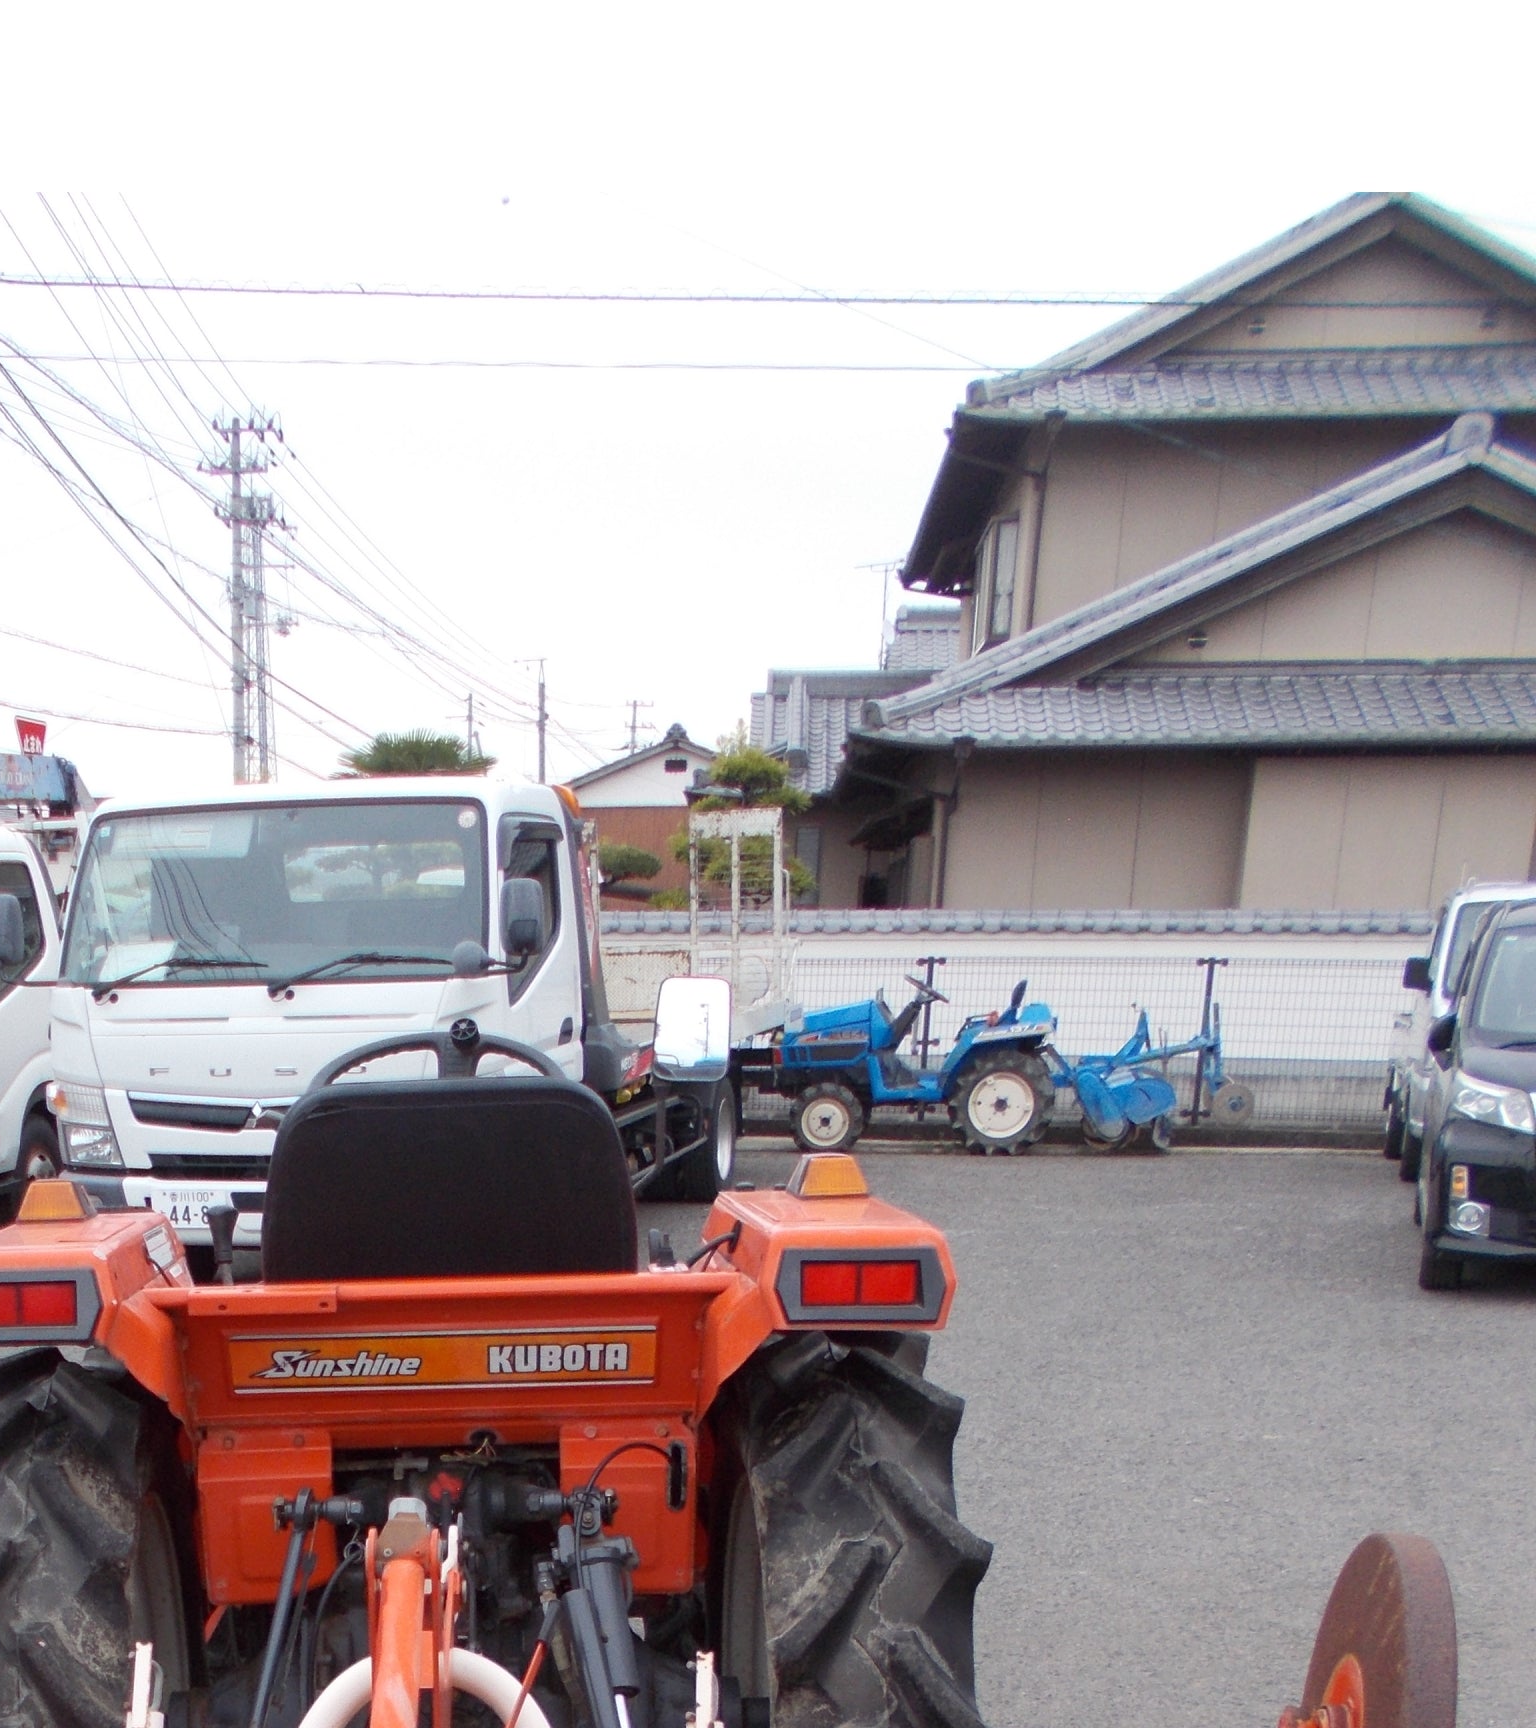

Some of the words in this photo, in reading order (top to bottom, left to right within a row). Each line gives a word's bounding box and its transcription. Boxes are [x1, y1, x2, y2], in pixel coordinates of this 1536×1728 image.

[169, 1205, 209, 1225] 44-8
[249, 1349, 422, 1379] Sunshine
[487, 1342, 628, 1375] KUBOTA
